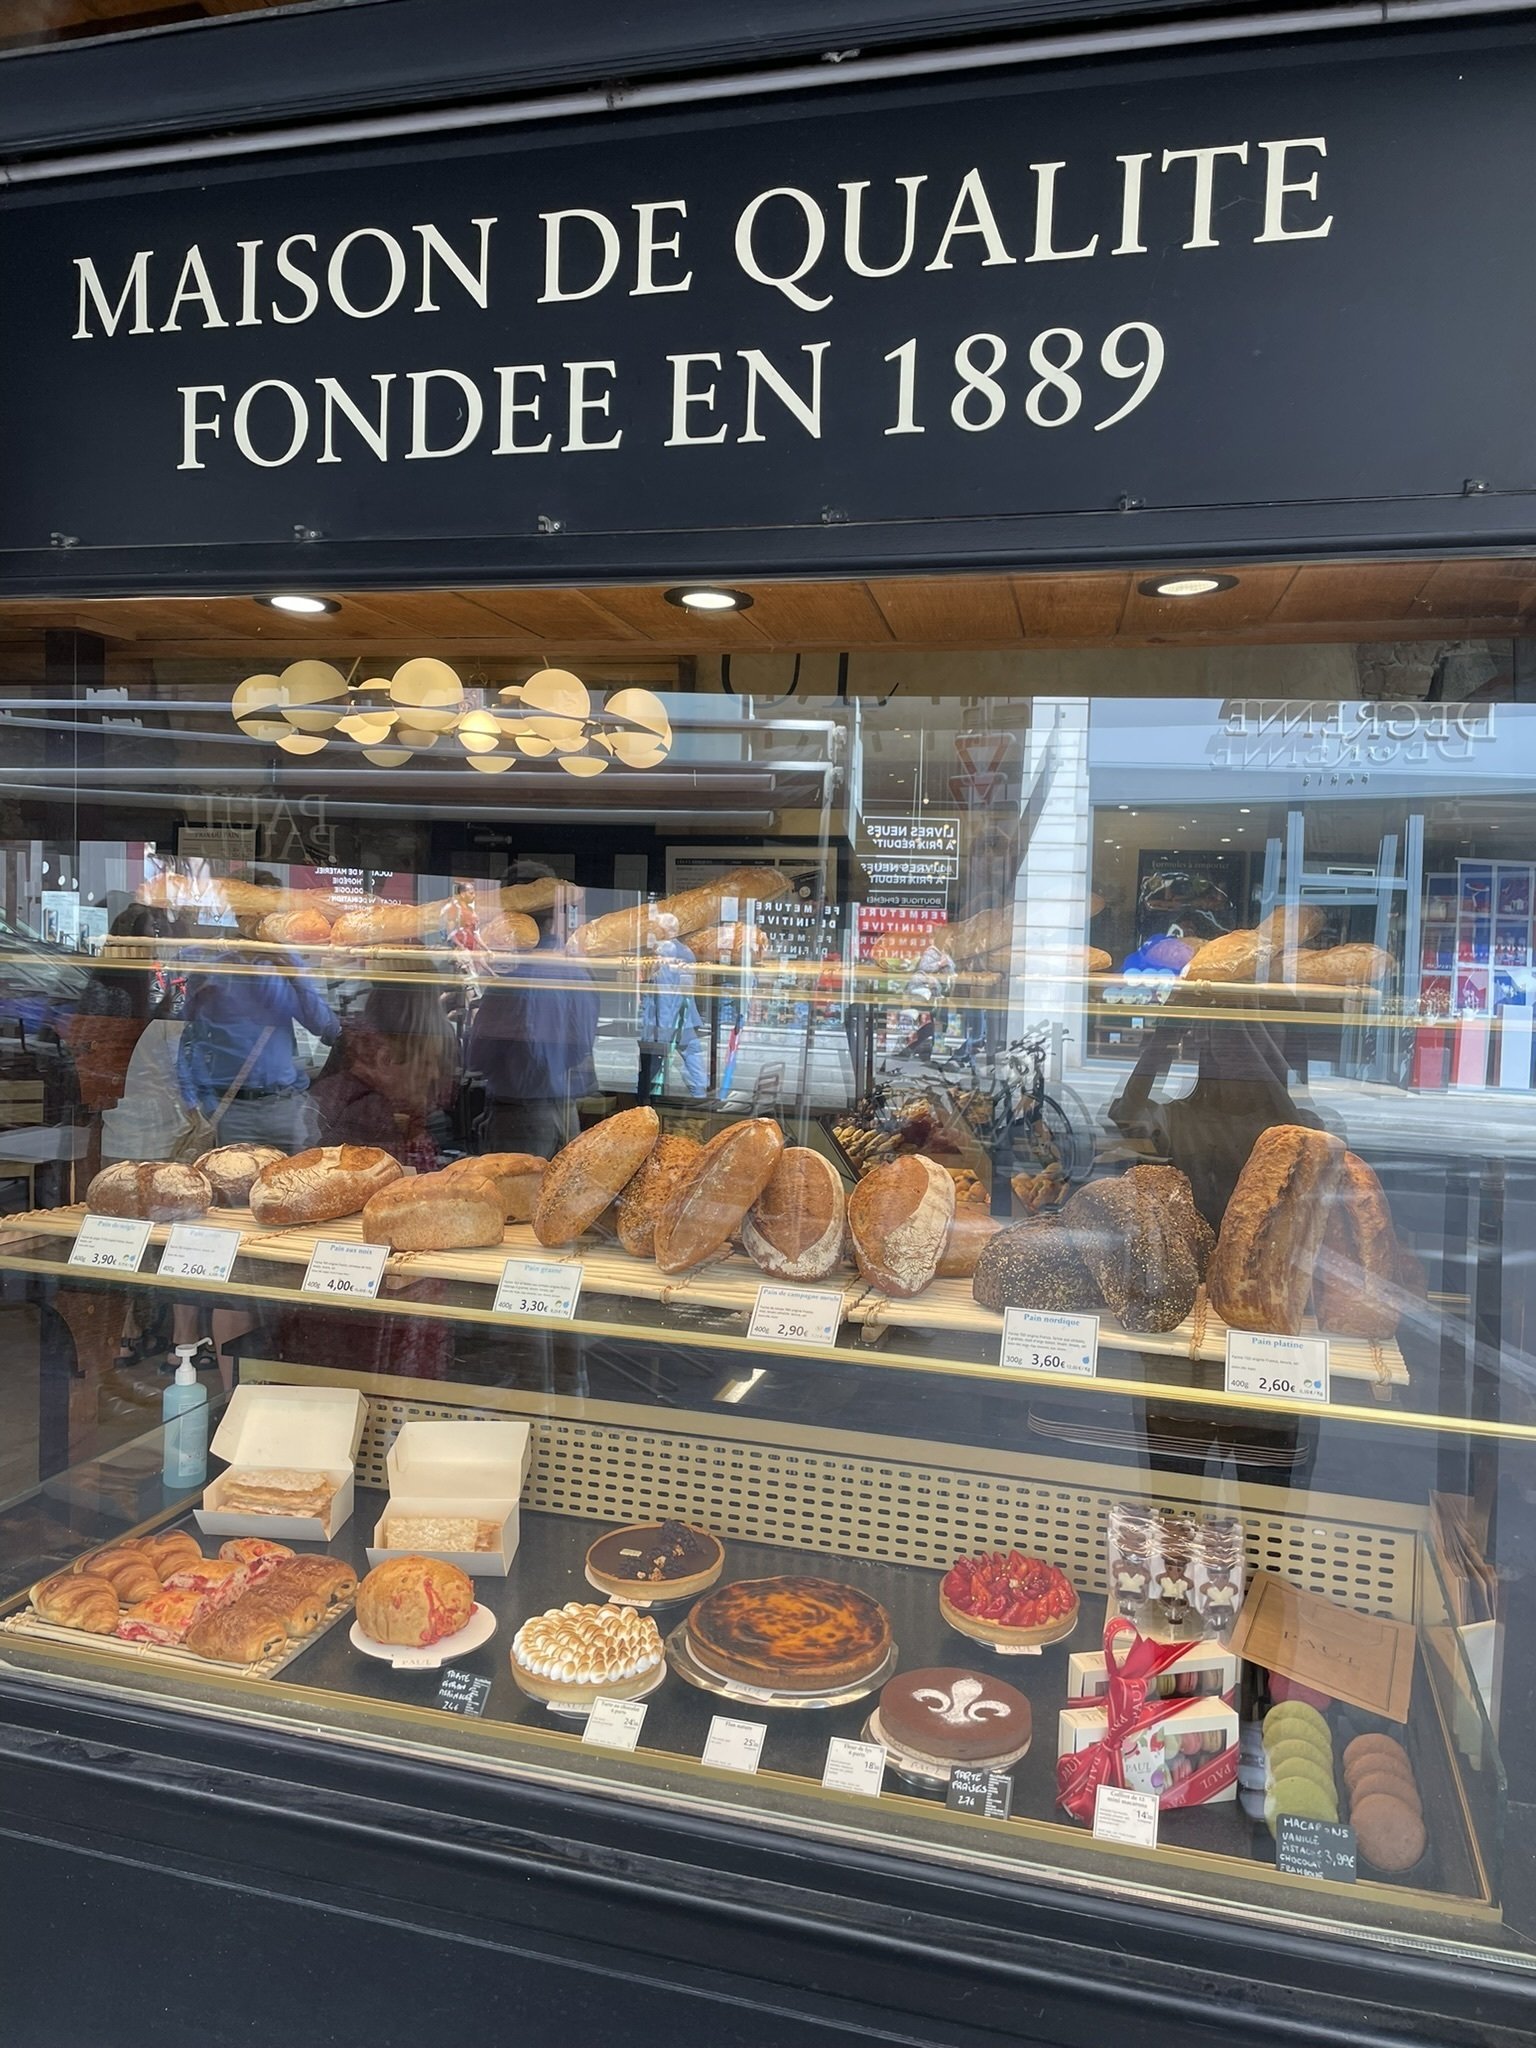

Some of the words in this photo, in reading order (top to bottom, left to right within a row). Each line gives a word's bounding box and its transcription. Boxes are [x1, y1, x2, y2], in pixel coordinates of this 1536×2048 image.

[72, 217, 498, 339] MAISON
[537, 200, 693, 304] DE
[735, 136, 1334, 312] QUALITE
[177, 360, 623, 470] FONDEE
[664, 341, 831, 447] EN
[884, 321, 1165, 435] 1889
[330, 1244, 345, 1252] Pain
[92, 1252, 117, 1265] 3,90€
[181, 1262, 206, 1275] 2,60€
[327, 1278, 354, 1292] 4,00€
[519, 1299, 549, 1312] 3,30€
[1023, 1313, 1042, 1321] Pain
[1043, 1317, 1080, 1327] nordique
[777, 1323, 809, 1337] 2,90€
[1251, 1337, 1271, 1345] Pain
[1031, 1353, 1065, 1368] 3,60€
[1230, 1379, 1249, 1389] 400g
[1258, 1377, 1296, 1392] 2,60€
[1126, 1762, 1152, 1773] PAUL
[954, 1769, 983, 1782] TARTE
[1200, 1763, 1232, 1790] PAUL
[952, 1780, 987, 1793] FRAISES
